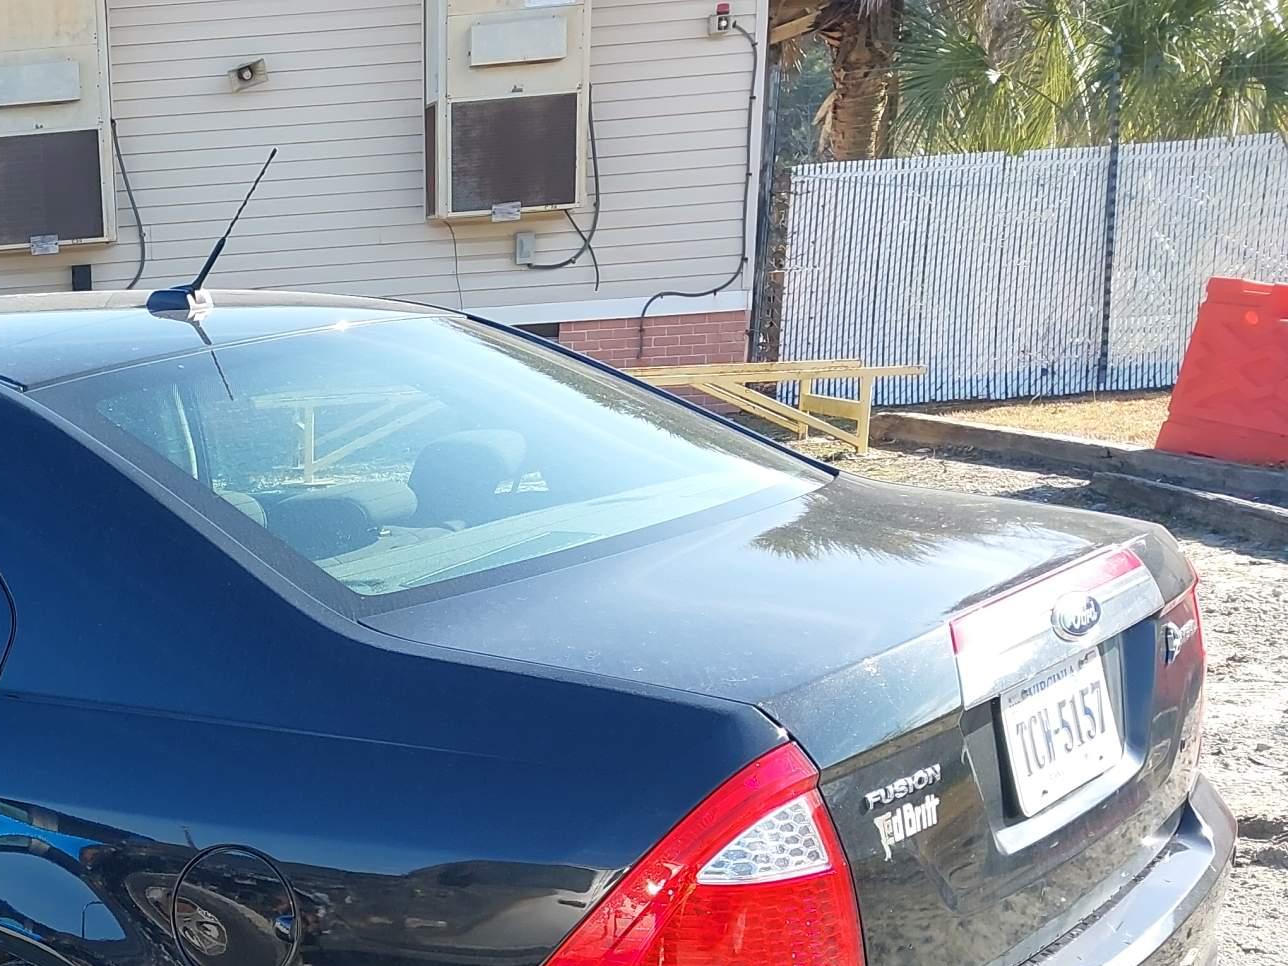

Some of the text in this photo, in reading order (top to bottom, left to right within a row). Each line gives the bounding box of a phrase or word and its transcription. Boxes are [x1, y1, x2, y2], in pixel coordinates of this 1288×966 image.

[864, 763, 941, 810] FUSION
[873, 793, 940, 862] Ted Britt
